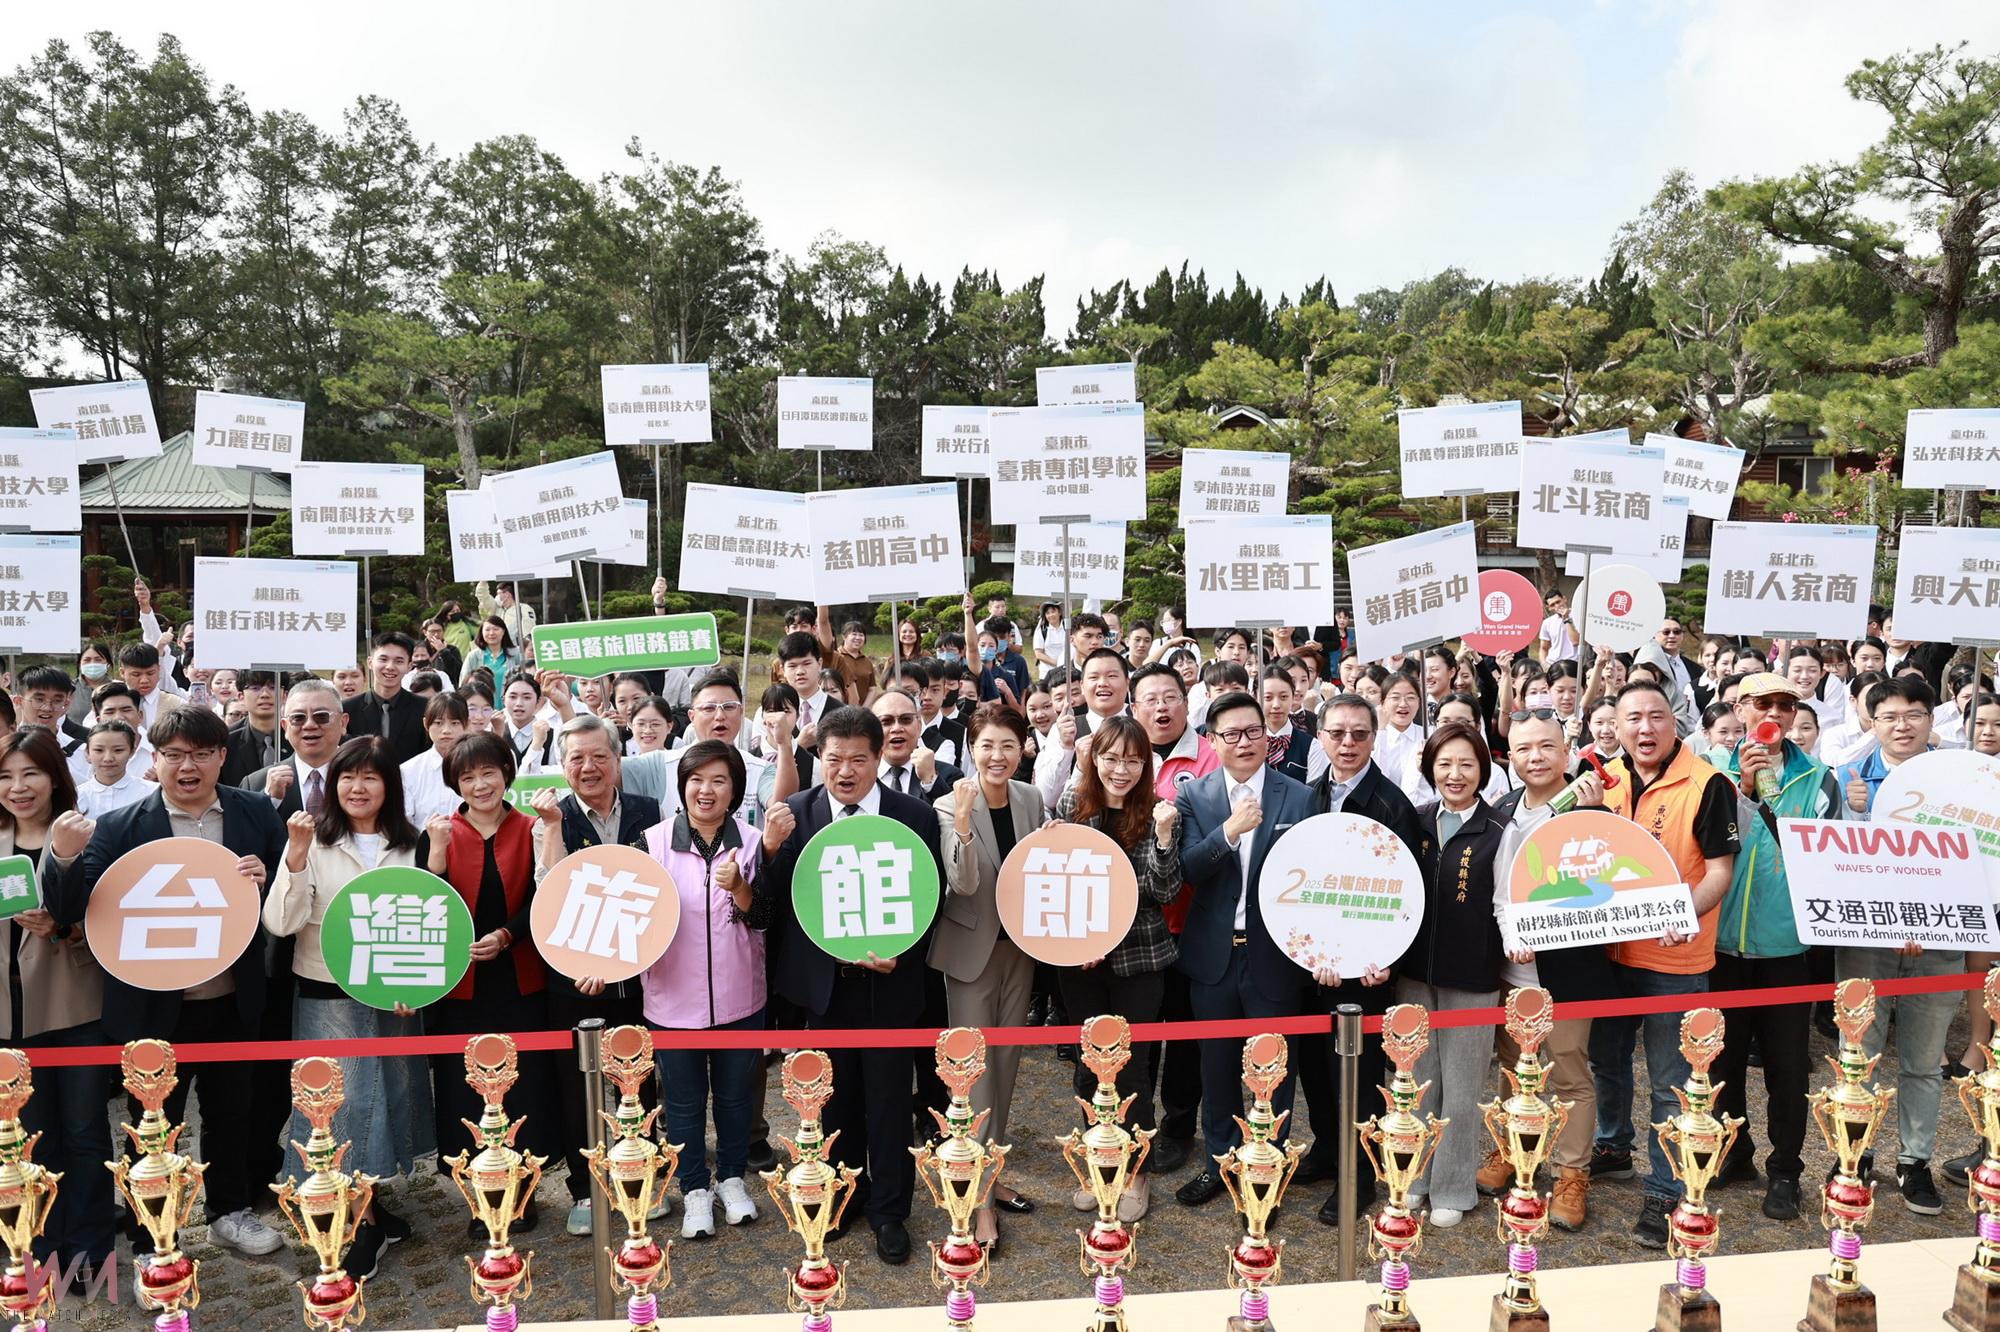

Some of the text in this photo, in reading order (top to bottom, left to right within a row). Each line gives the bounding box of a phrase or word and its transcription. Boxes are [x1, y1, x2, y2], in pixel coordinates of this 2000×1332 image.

[204, 426, 293, 454] 力麗哲園
[1044, 434, 1089, 450] 臺東市
[1912, 446, 2000, 462] 弘光科技大
[996, 455, 1138, 481] 臺東專科學校
[1573, 468, 1614, 484] 彰化縣
[300, 506, 415, 524] 南開科技大學
[503, 496, 620, 534] 臺南應用科技大學
[1206, 497, 1261, 513] 渡假酒店
[1532, 484, 1651, 521] 北斗家商
[737, 514, 778, 531] 新北市
[862, 514, 906, 531] 臺中市
[686, 532, 811, 560] 宏國德霖科技大
[823, 533, 950, 571] 慈明高中
[1239, 544, 1281, 558] 南投縣
[1768, 552, 1815, 567] 新北市
[1199, 562, 1322, 592] 水里商工
[1398, 562, 1434, 582] 臺中市
[253, 587, 301, 601] 桃園市
[1365, 573, 1469, 626] 嶺東高中
[1721, 569, 1858, 604] 樹人家商
[205, 609, 347, 632] 健行科技大學
[539, 628, 712, 662] 全國餐旅服務競賽
[1789, 824, 1970, 861] TAIWAN
[1834, 863, 1942, 877] WAVES OF WONDER
[818, 840, 914, 939] 館
[1022, 847, 1112, 939] 節
[118, 863, 229, 961] 台
[545, 862, 661, 965] 旅
[1516, 898, 1687, 934] 南投縣旅館商業同業公會
[1805, 898, 1987, 930] 交通部觀光署
[349, 892, 449, 987] 灣
[1518, 918, 1689, 948] Nantou Hotel Association
[1810, 926, 1991, 944] Tourism Administration, MOTC
